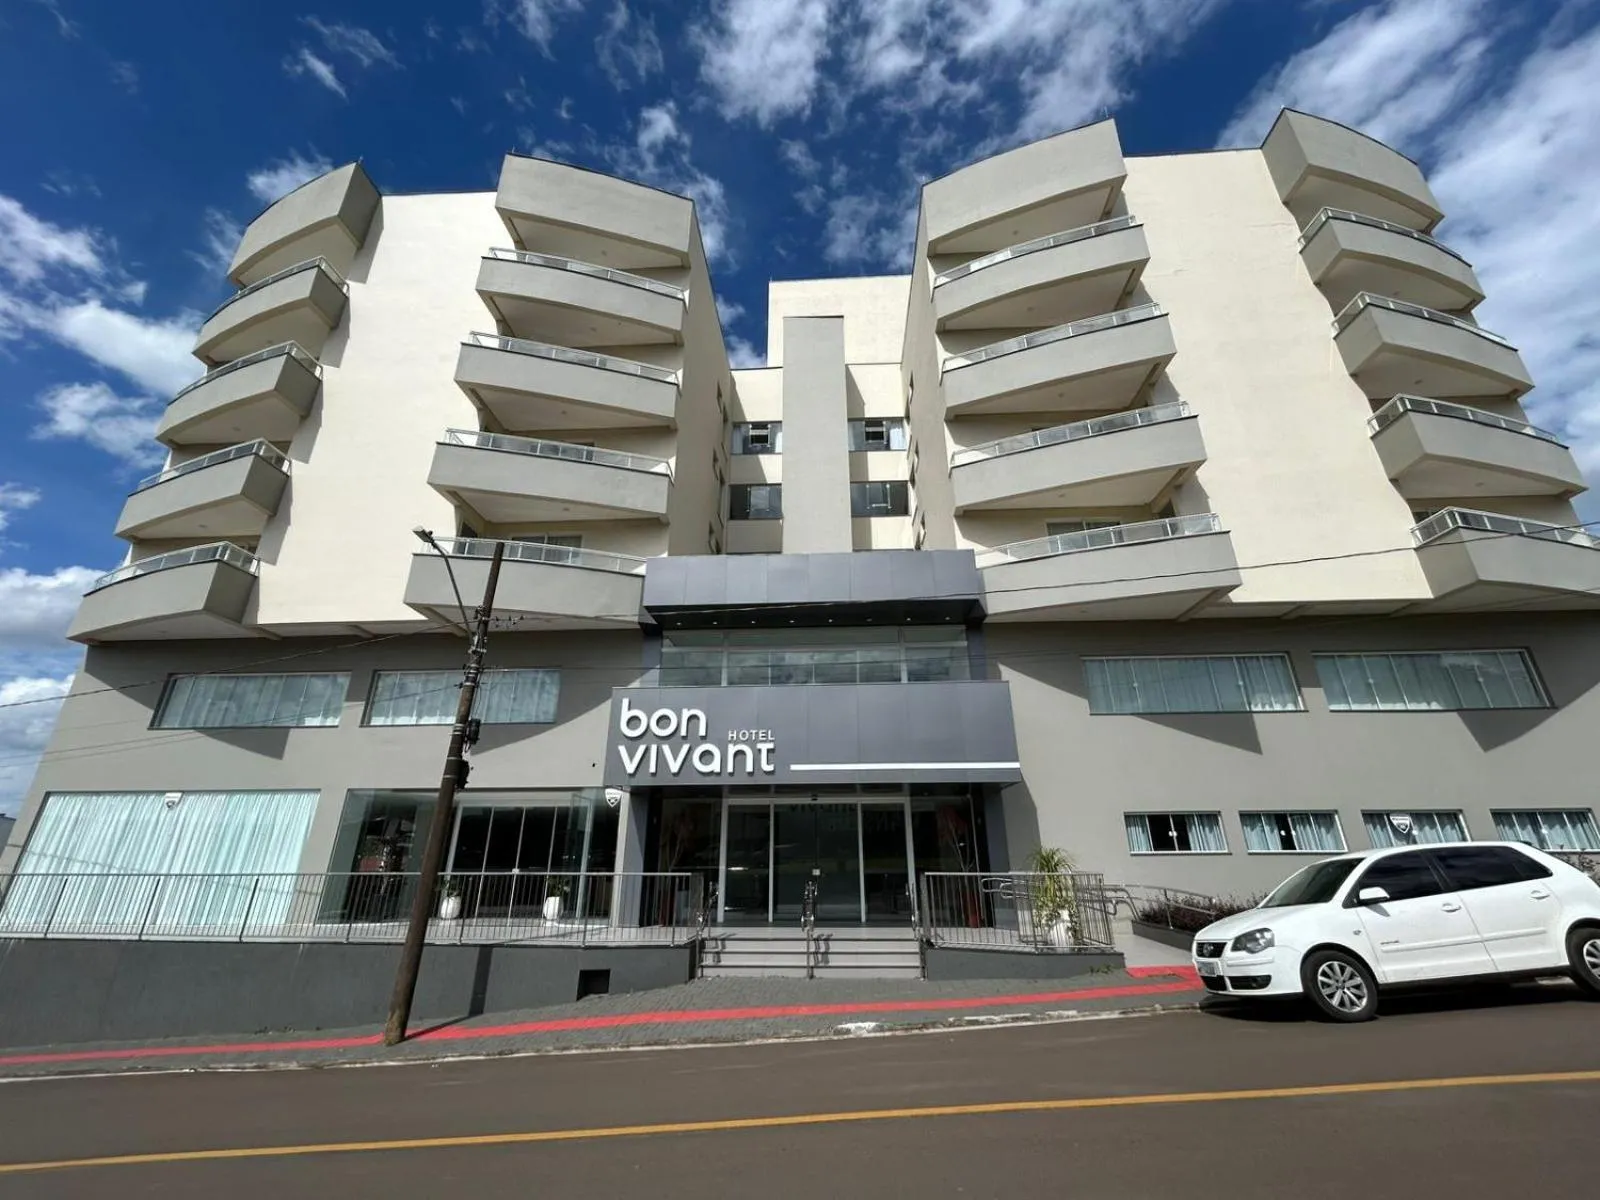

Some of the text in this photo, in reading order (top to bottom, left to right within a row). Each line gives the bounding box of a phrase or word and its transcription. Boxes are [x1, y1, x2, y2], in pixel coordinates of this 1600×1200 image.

[620, 698, 707, 738] bon
[728, 730, 775, 741] HOTEL
[618, 743, 775, 774] vivant
